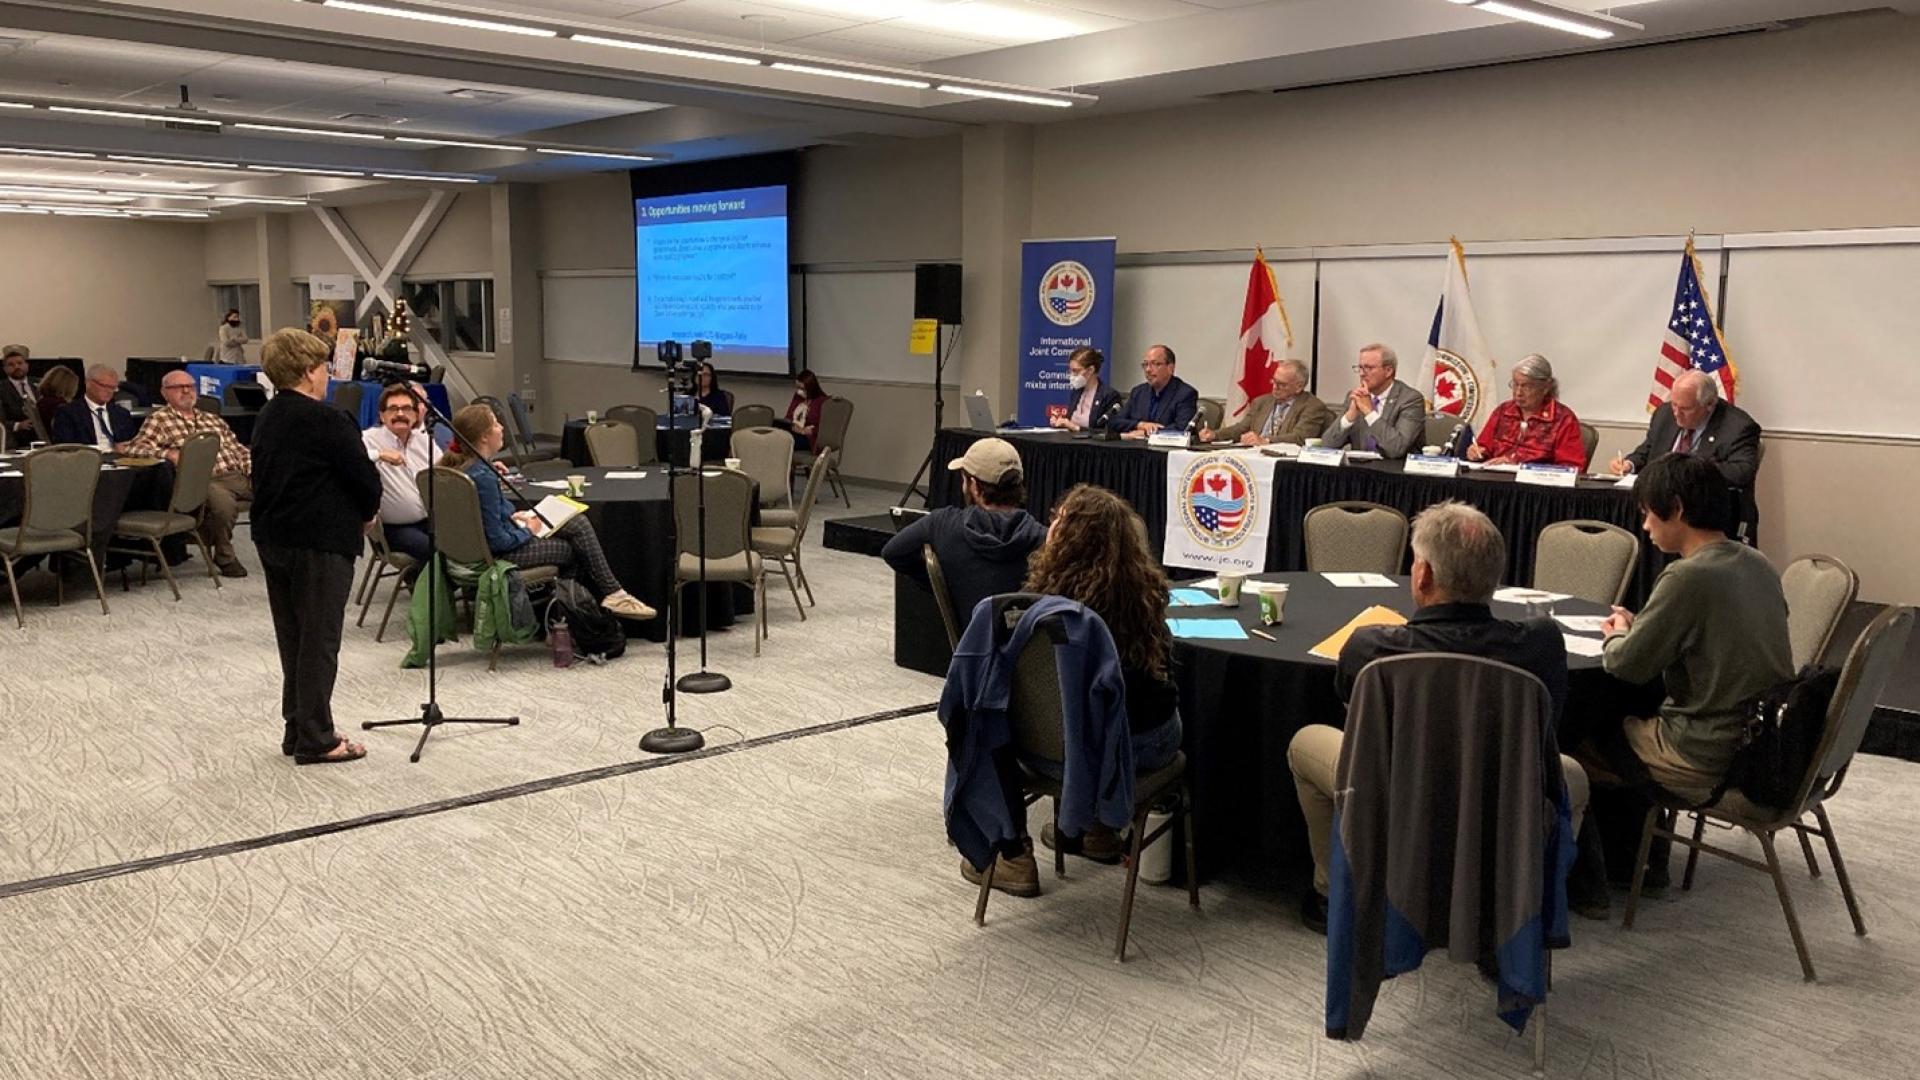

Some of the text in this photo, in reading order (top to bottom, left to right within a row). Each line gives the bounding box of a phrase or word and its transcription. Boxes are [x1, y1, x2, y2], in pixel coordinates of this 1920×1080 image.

[648, 204, 690, 218] Opportunities
[692, 202, 717, 214] moving
[718, 199, 745, 211] forward
[1040, 337, 1091, 346] International
[1029, 347, 1050, 356] Joint
[1025, 380, 1047, 390] mixte
